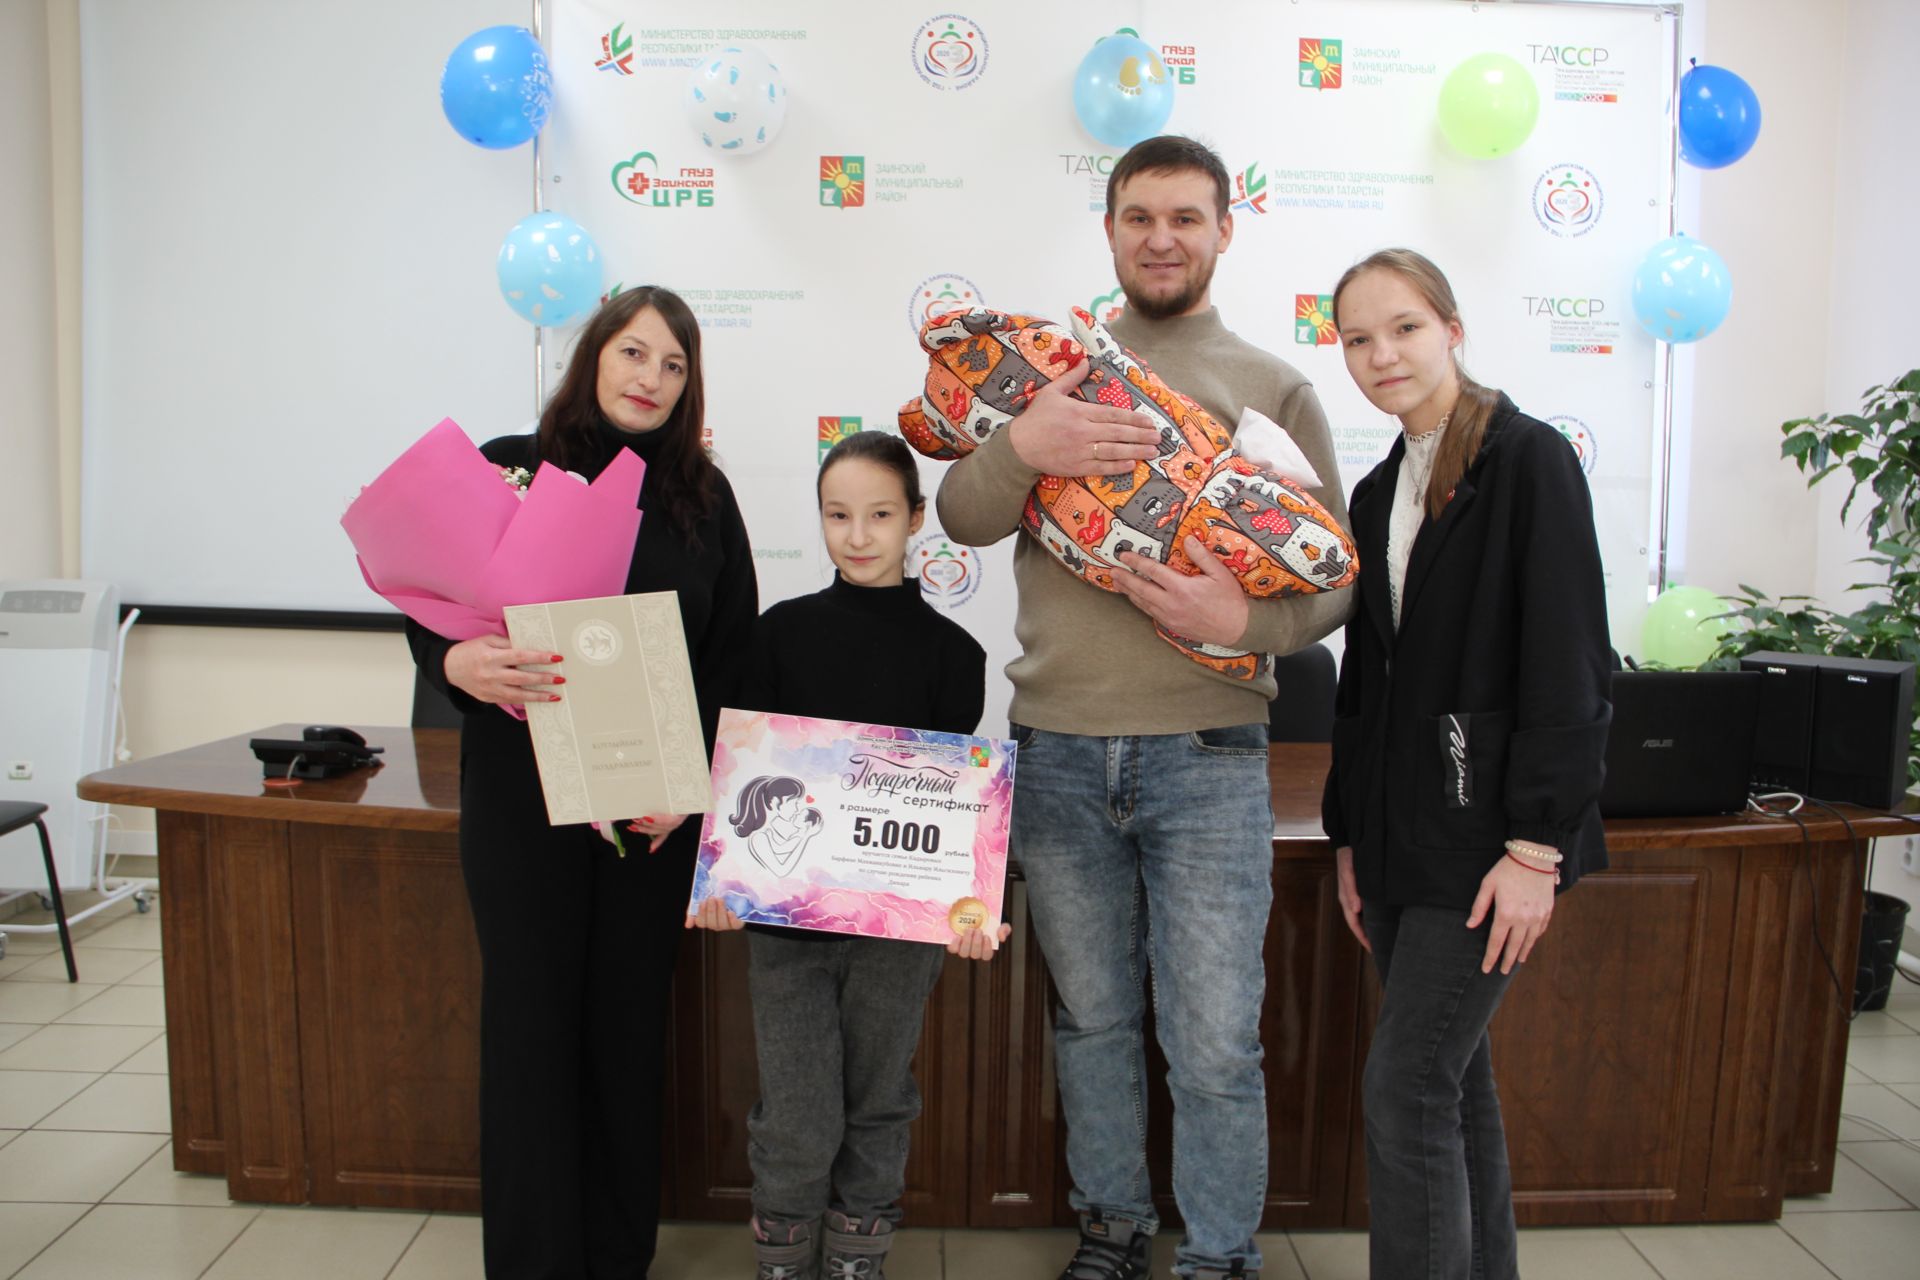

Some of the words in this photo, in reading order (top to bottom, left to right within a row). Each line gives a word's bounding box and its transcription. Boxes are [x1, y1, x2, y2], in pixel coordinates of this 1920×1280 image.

[641, 29, 714, 40] МИНИСТЕРСТВО
[717, 29, 807, 40] ЗДРАВООХРАНЕНИЯ
[641, 43, 702, 53] РЕСПУБЛИКИ
[1352, 47, 1401, 58] ЗАИНСКИЙ
[1352, 61, 1436, 74] МУНИЦИПАЛЬНЫЙ
[1352, 74, 1383, 85] РАЙОН
[876, 162, 926, 174] ЗАИНСКИЙ
[1275, 169, 1346, 181] МИНИСТЕРСТВО
[1348, 172, 1434, 184] ЗДРАВООХРАНЕНИЯ
[875, 177, 963, 189] МУНИЦИПАЛЬНЫЙ
[1275, 183, 1334, 194] РЕСПУБЛИКИ
[1336, 185, 1384, 196] ТАТАРСТАН
[652, 189, 714, 207] ЦРБ
[875, 191, 907, 201] РАЙОН
[715, 289, 805, 301] ЗДРАВООХРАНЕНИЯ
[703, 304, 752, 314] ТАТАРСТАН
[1449, 713, 1469, 806] Miami
[847, 804, 890, 815] размере
[903, 796, 989, 813] сертификат
[853, 816, 941, 854] 5.000
[945, 850, 970, 858] рублей
